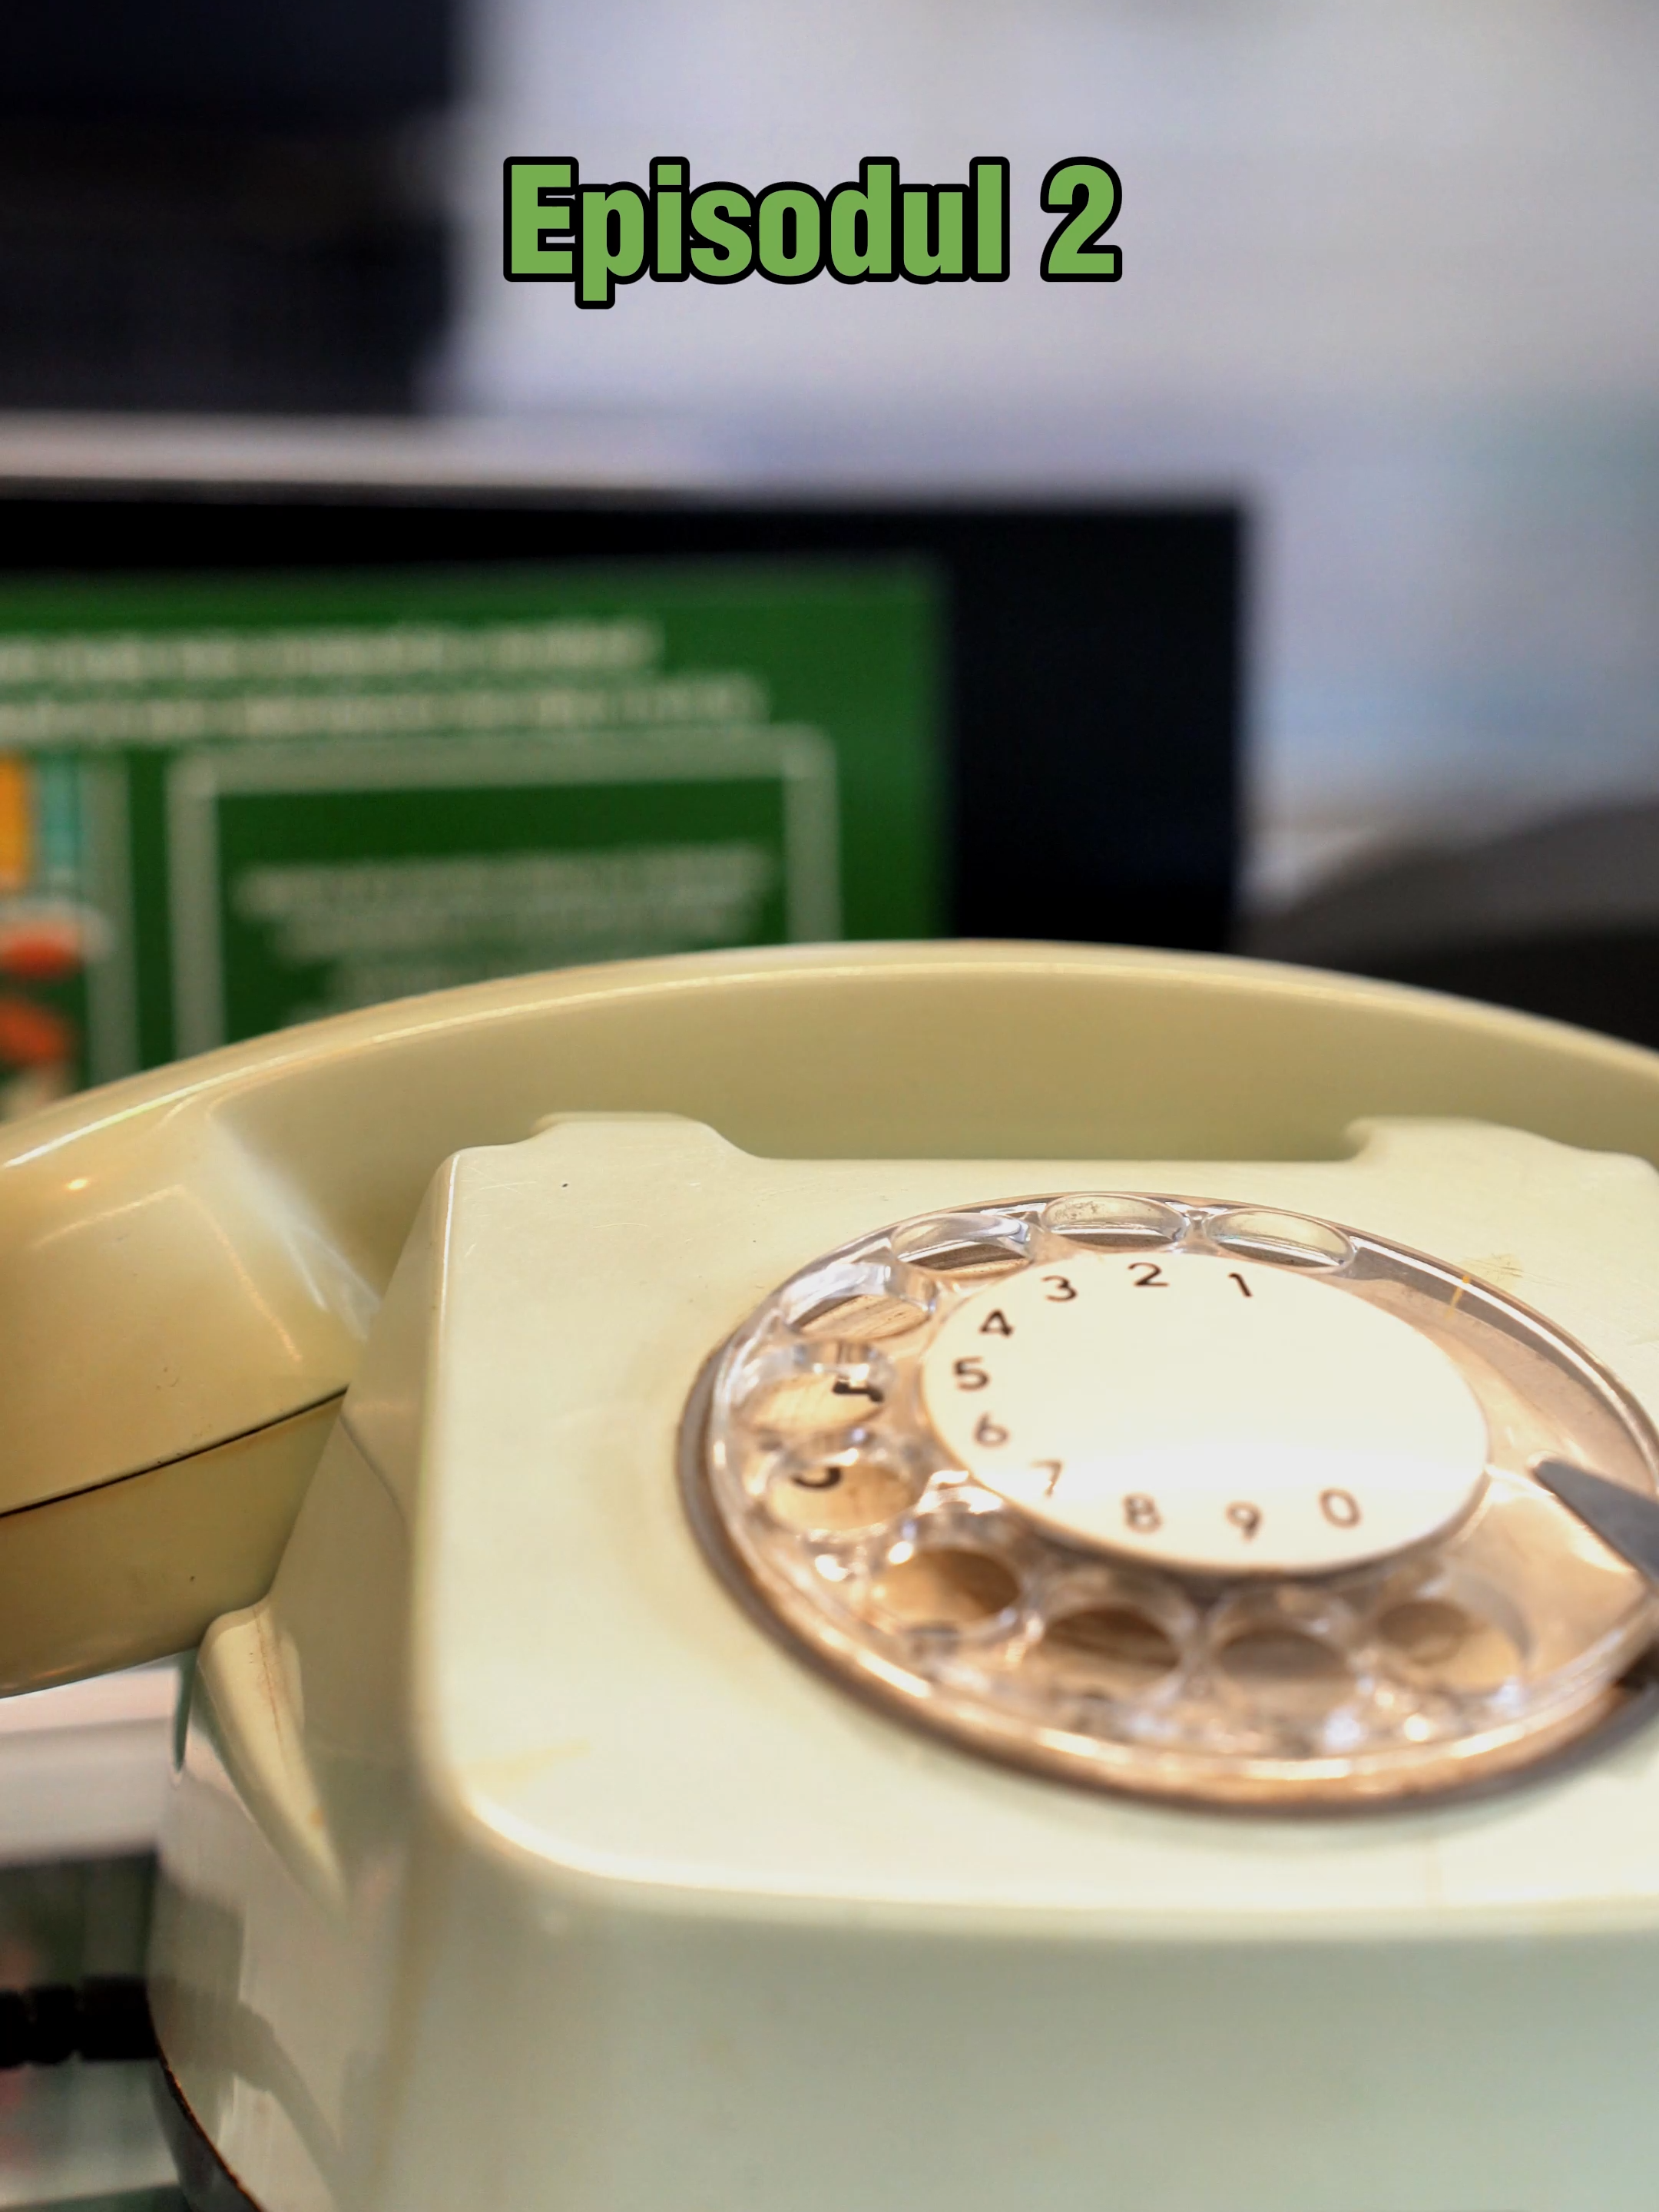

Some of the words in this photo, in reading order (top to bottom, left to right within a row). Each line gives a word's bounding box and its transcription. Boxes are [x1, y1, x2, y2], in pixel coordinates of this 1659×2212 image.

[1041, 1275, 1078, 1302] 3
[1127, 1262, 1169, 1287] 2
[1229, 1272, 1253, 1297] 1
[979, 1309, 1014, 1337] 4
[953, 1356, 990, 1391] 5
[972, 1413, 1009, 1448] 6
[1030, 1459, 1064, 1497] 7
[1122, 1492, 1162, 1534] 8
[1226, 1500, 1262, 1544] 9
[1319, 1488, 1361, 1528] 0
